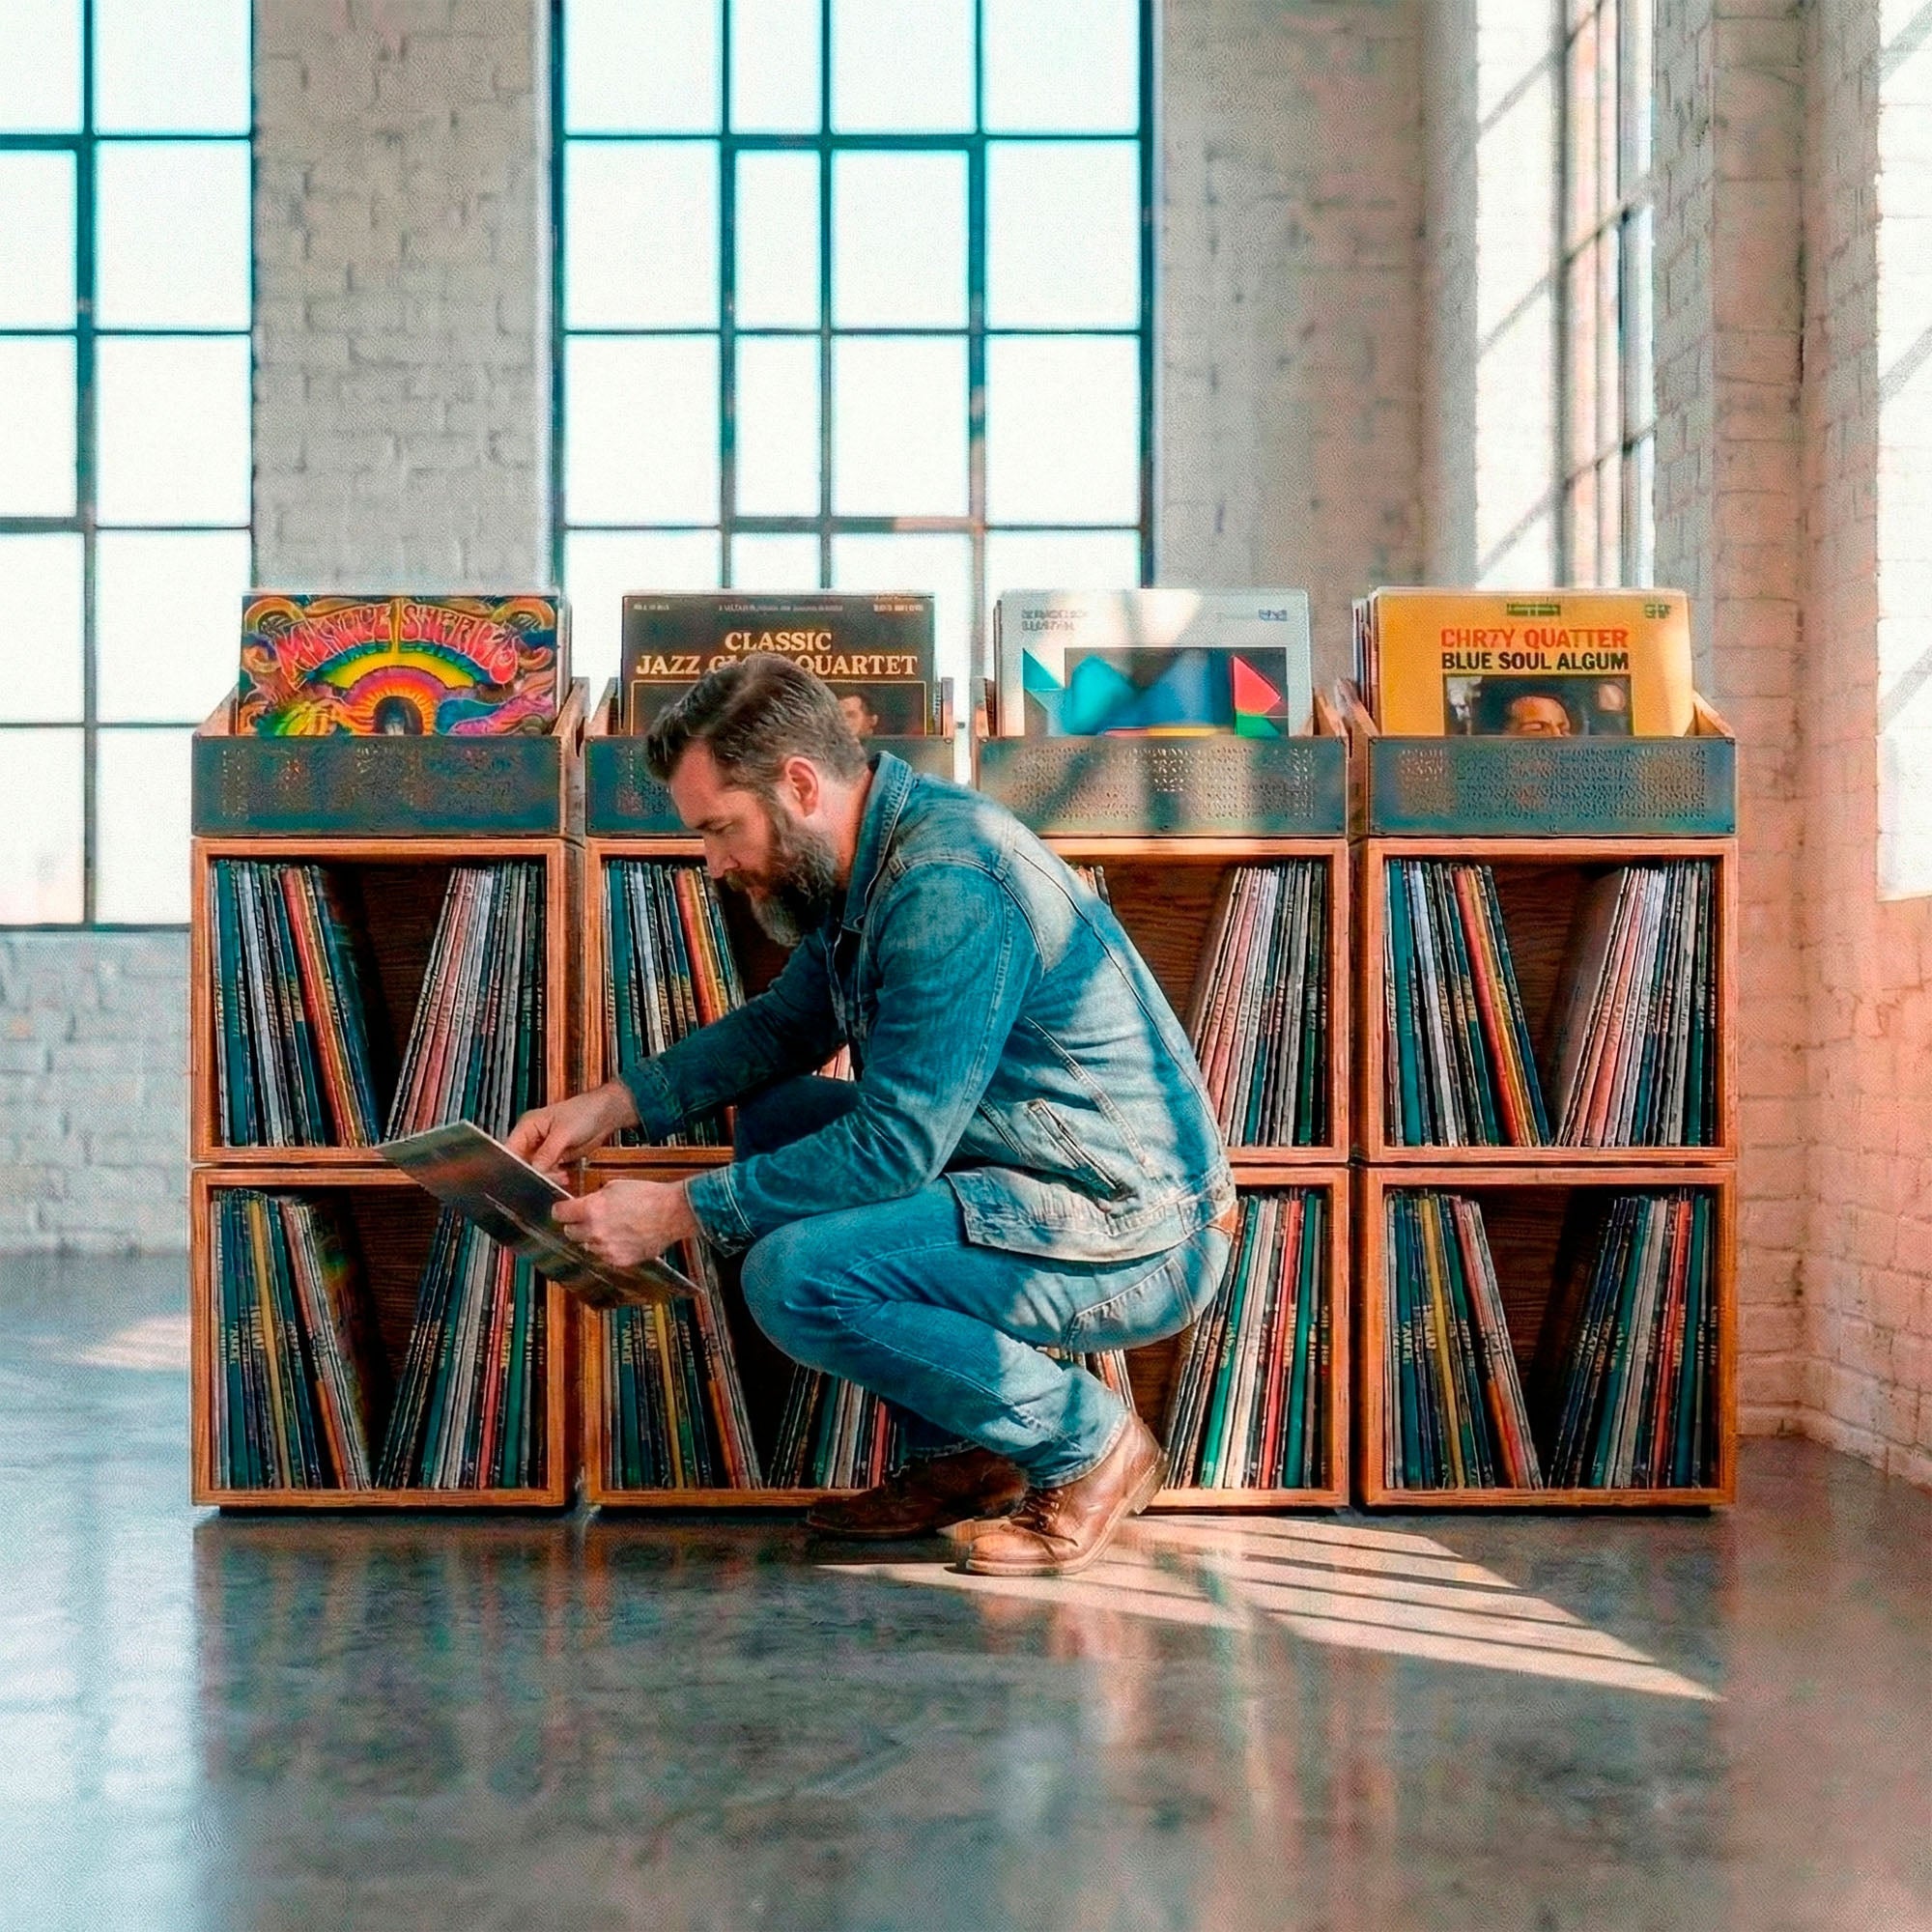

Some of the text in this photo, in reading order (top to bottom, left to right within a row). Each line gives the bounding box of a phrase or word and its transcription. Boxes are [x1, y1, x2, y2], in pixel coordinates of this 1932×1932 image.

[724, 632, 833, 651] CLASSIC
[1523, 629, 1628, 649] QUATTER
[636, 655, 700, 675] JAZZ
[796, 655, 918, 675] QUARTET
[1441, 652, 1629, 670] BLUE SOUL ALGUM
